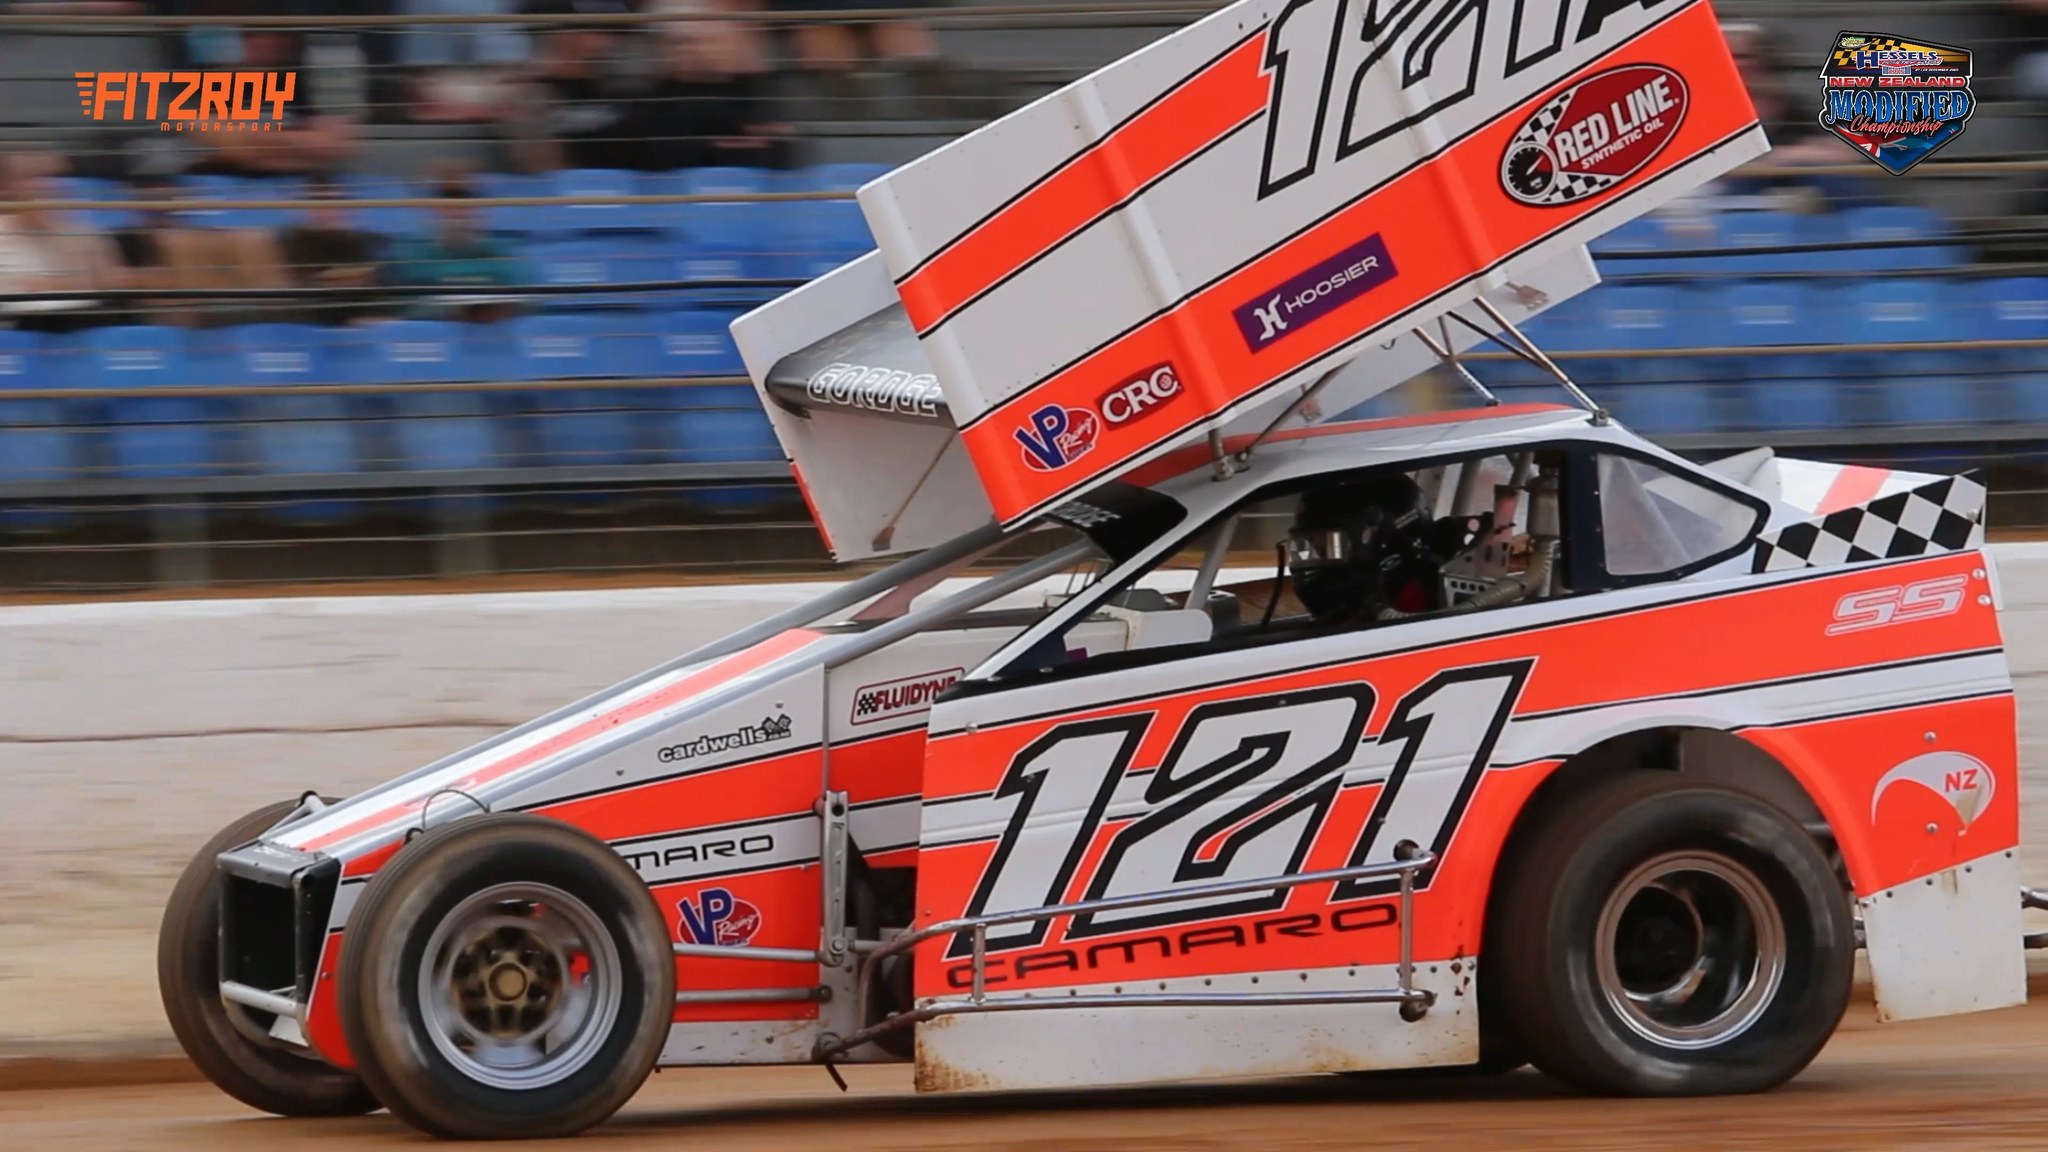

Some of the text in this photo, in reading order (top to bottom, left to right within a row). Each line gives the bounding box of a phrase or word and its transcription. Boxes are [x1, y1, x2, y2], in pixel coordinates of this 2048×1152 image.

[1554, 74, 1674, 168] RED LINE
[1581, 118, 1664, 170] SYNTHETIC OIL
[1284, 255, 1379, 314] HOOSIER
[1102, 366, 1178, 422] CRC
[1013, 403, 1069, 469] VP
[1060, 416, 1095, 454] Racing
[1824, 574, 1969, 636] SS
[657, 726, 767, 762] cardwells
[941, 656, 1539, 961] 121
[1944, 768, 1978, 793] NZ
[676, 887, 735, 945] VP
[717, 912, 759, 941] Racing
[946, 902, 1398, 989] CAMARO
